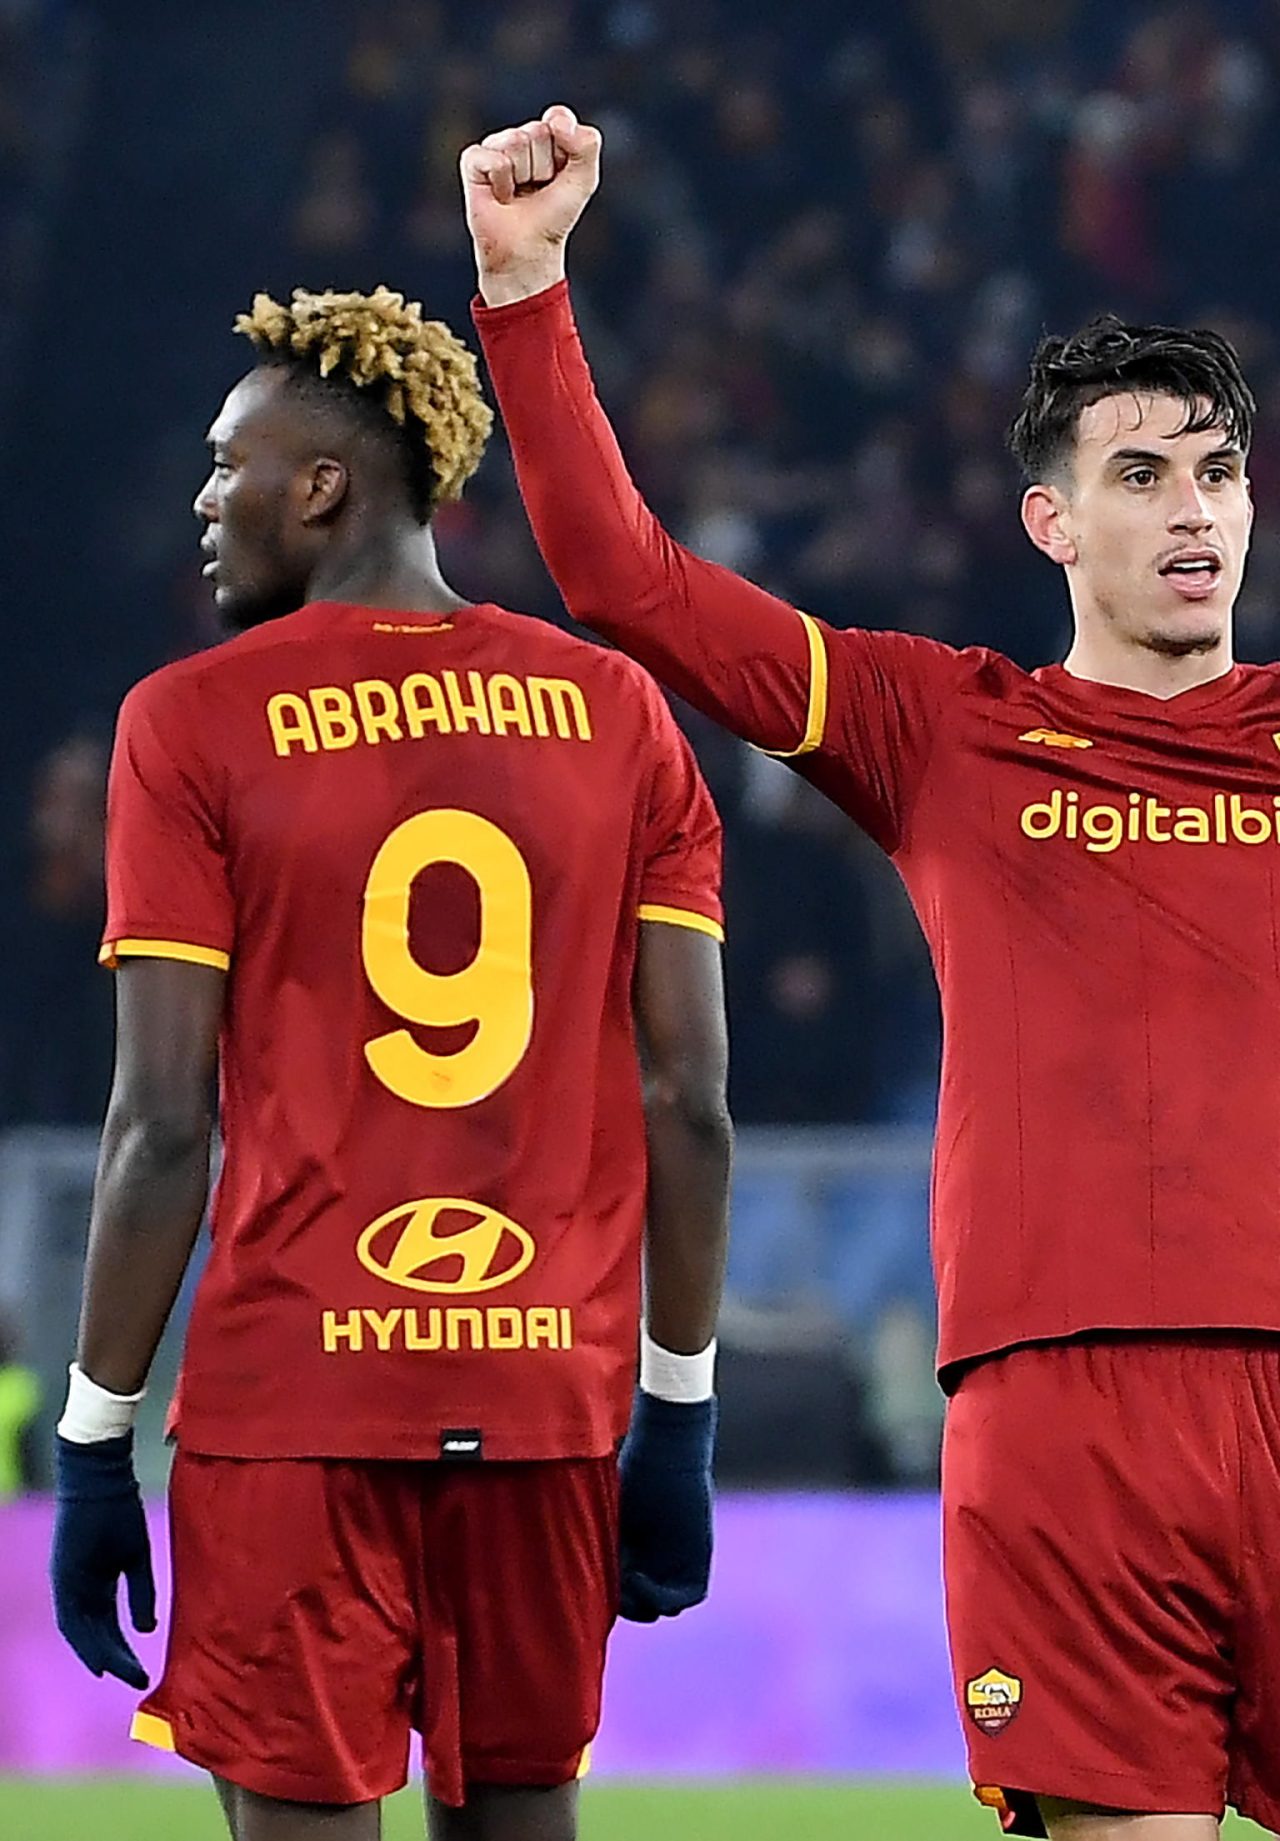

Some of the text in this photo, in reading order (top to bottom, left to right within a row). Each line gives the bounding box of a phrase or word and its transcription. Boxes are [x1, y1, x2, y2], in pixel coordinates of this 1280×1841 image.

[266, 670, 592, 757] ABRAHAM
[361, 808, 534, 1109] 9
[321, 1307, 573, 1353] HYUNDAI
